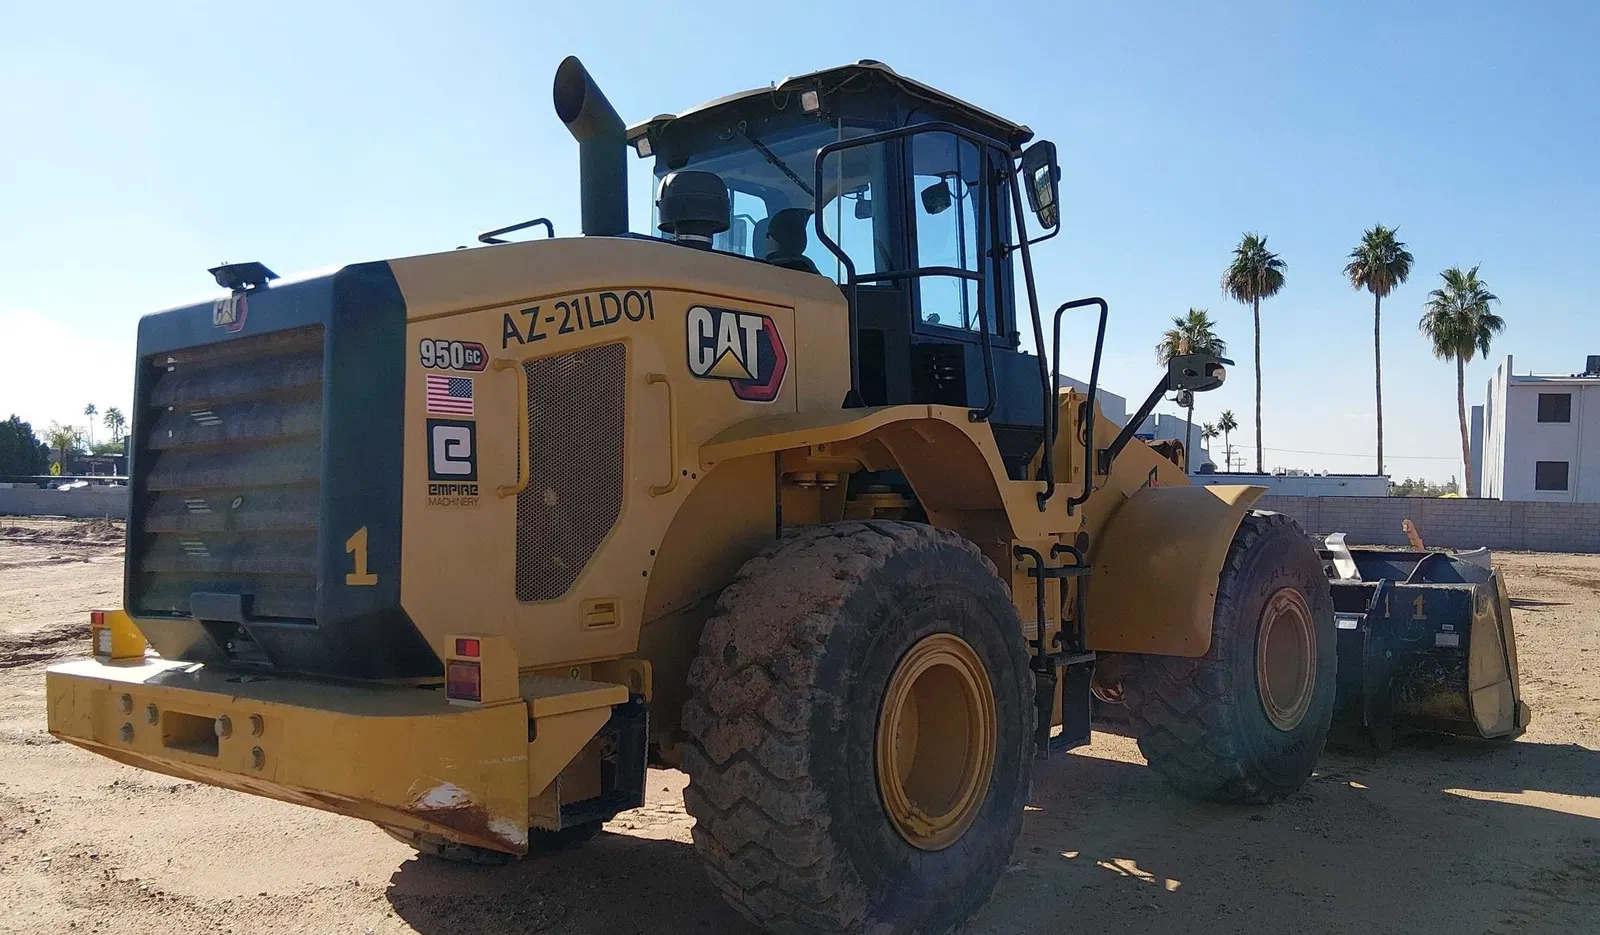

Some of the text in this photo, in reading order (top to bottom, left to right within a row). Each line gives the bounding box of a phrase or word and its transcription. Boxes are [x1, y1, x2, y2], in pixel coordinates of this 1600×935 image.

[213, 296, 240, 326] CAT
[420, 339, 481, 369] 950 GC
[688, 306, 763, 380] CAT
[428, 497, 480, 507] MACHINERY
[346, 526, 378, 586] 1
[1412, 594, 1427, 620] 1
